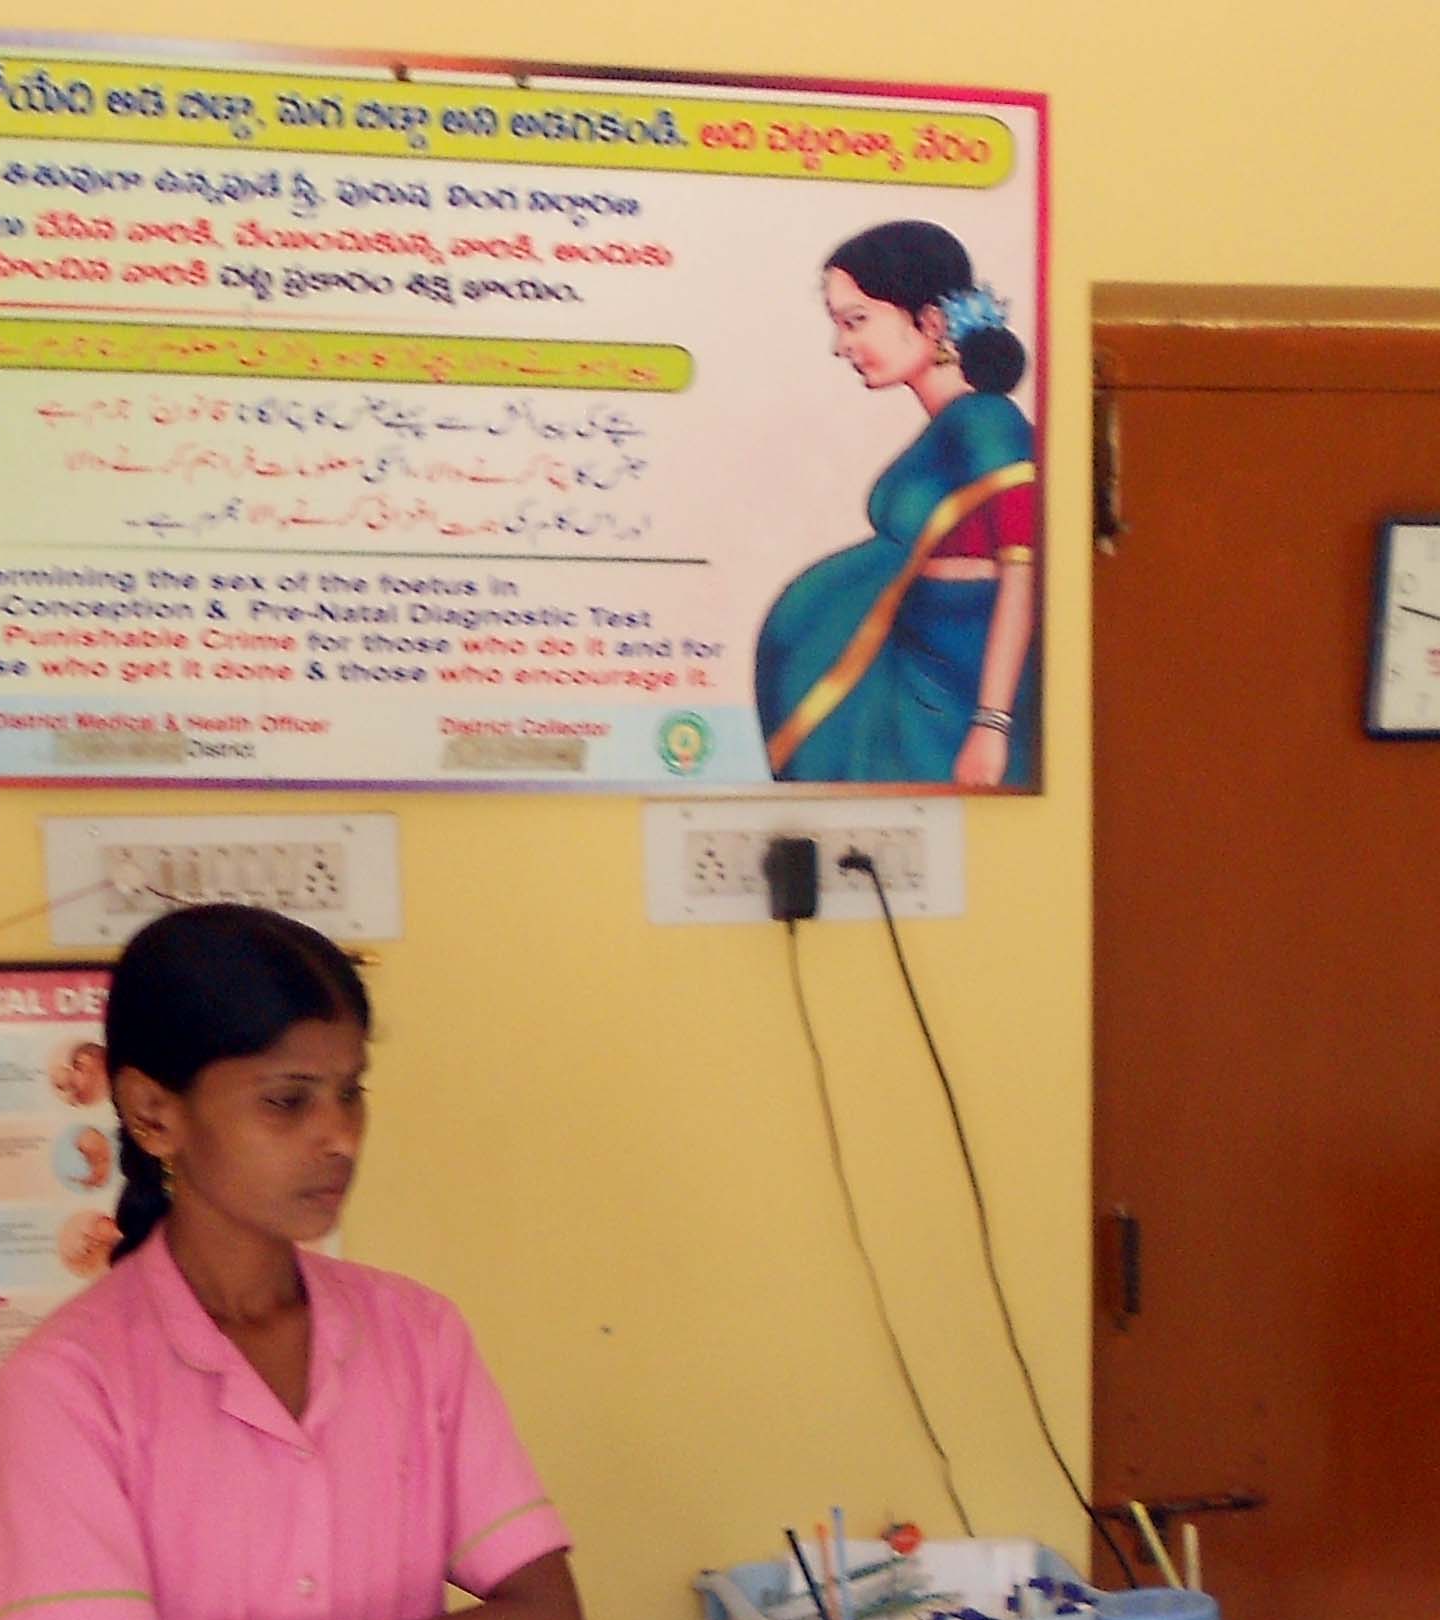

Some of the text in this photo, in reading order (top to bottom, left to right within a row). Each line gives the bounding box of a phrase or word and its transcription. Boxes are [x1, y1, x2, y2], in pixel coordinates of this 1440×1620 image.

[147, 568, 198, 590] the
[210, 573, 263, 591] sex
[277, 571, 308, 593] of
[319, 573, 368, 594] the
[379, 573, 479, 596] foetus
[488, 575, 517, 596] in
[206, 599, 226, 621] &
[250, 600, 397, 622] Pre-Natal
[409, 603, 577, 630] Diagnostic
[588, 606, 651, 629] Test
[4, 625, 189, 649] Punishable
[200, 627, 296, 651] Crime
[308, 633, 352, 651] for
[363, 634, 451, 654] those
[462, 637, 527, 655] who
[537, 637, 576, 655] do
[616, 639, 672, 657] and
[682, 638, 725, 658] for
[40, 656, 109, 678] who
[119, 660, 171, 683] get
[213, 659, 294, 680] done
[306, 659, 327, 681] &
[338, 663, 427, 683] those
[437, 665, 503, 684] who
[514, 667, 677, 692] encourage
[75, 710, 155, 732] Medical
[186, 713, 252, 732] Health
[259, 714, 329, 734] Officer
[440, 716, 611, 737] District Collector
[54, 986, 110, 1016] DE
